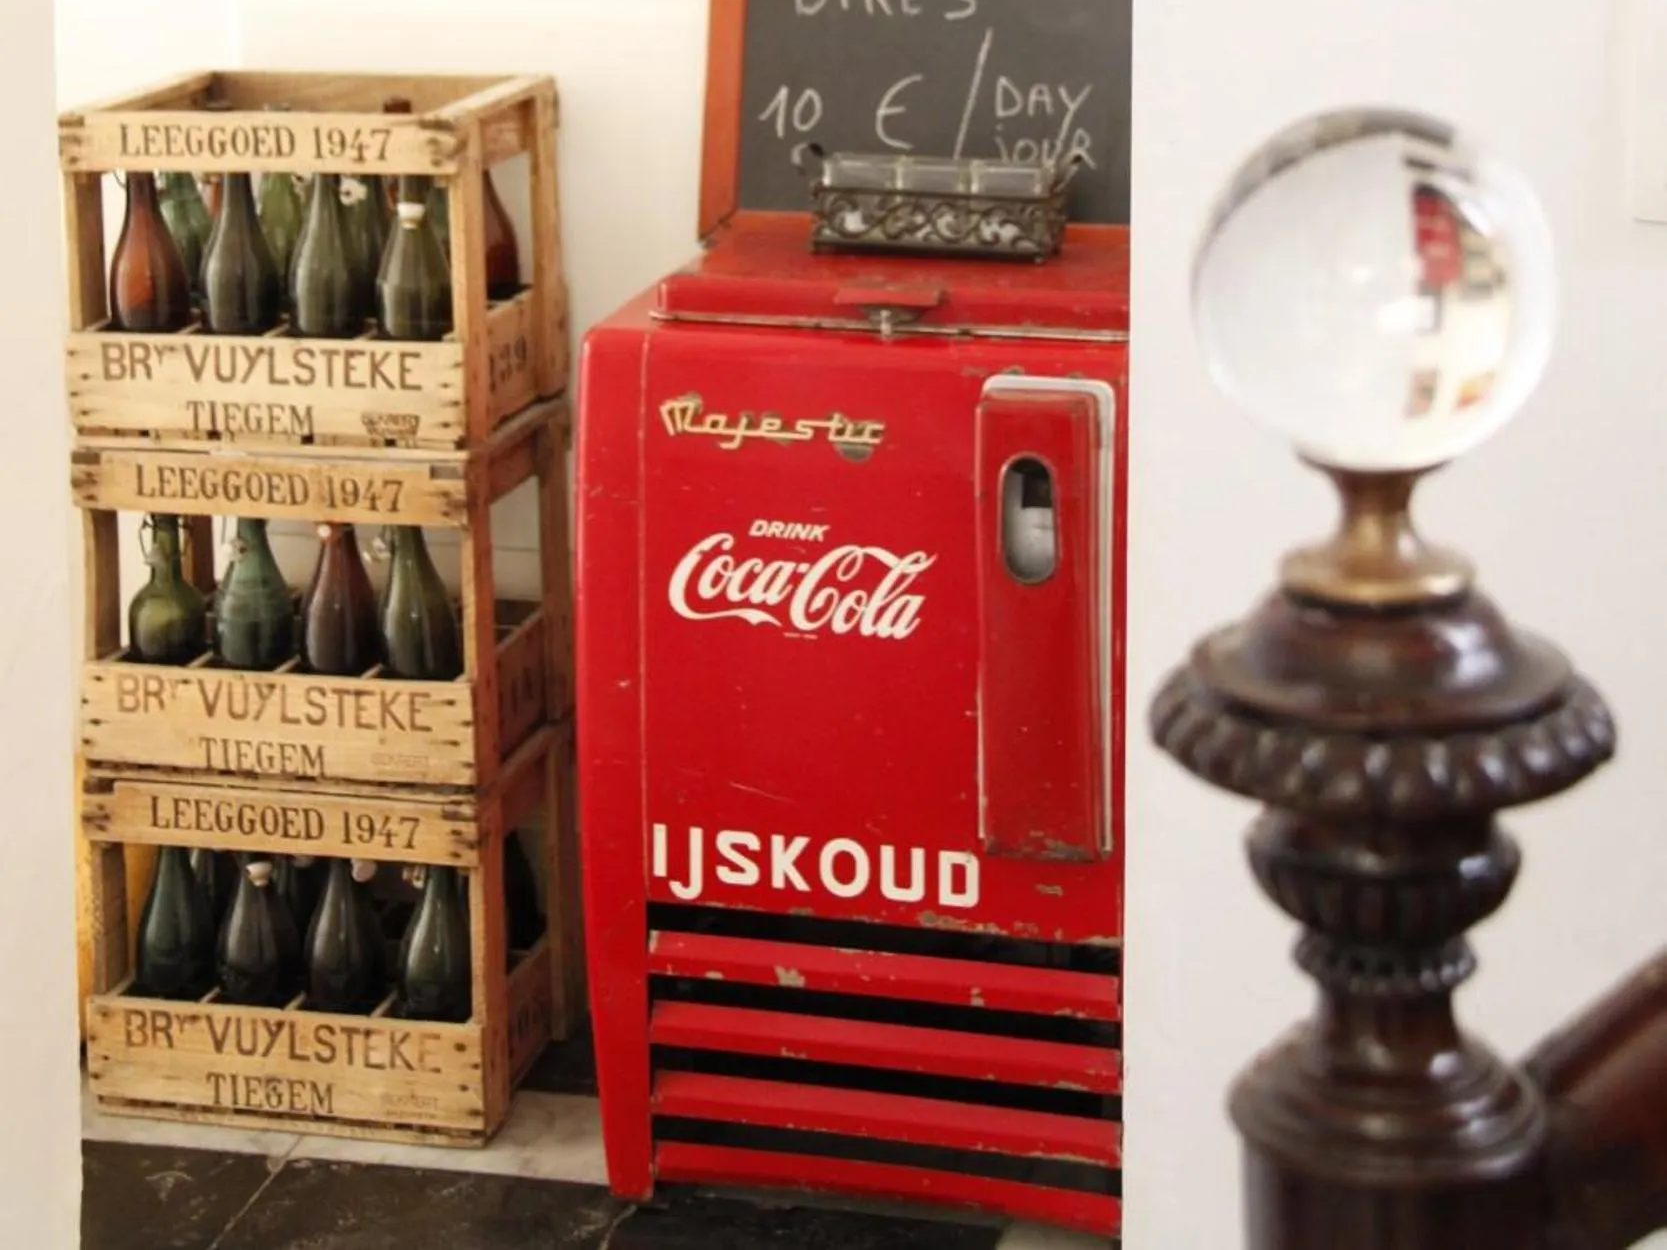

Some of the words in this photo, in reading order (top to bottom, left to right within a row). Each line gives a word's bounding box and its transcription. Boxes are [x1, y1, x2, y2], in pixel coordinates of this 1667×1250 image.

[758, 84, 823, 138] 10
[875, 74, 923, 150] €
[995, 76, 1093, 158] DAY
[119, 123, 295, 160] LEEGGOED
[312, 126, 393, 163] 1947
[184, 343, 423, 391] VUYLSTEKE
[186, 400, 314, 436] TIEGEM
[660, 399, 884, 449] Majestic
[135, 464, 310, 507] LEEGGOED
[323, 473, 404, 512] 1947
[749, 519, 830, 542] DRINK
[669, 532, 937, 640] Coca-Cola
[197, 678, 433, 732] VUYLSTEKE
[199, 736, 326, 777] TIEGEM
[150, 796, 325, 841] LEEGGOED
[341, 810, 420, 849] 1947
[652, 823, 979, 908] IJSKOUD
[203, 1013, 442, 1074] VUYLSTEKE
[206, 1073, 335, 1114] TIEGEM
